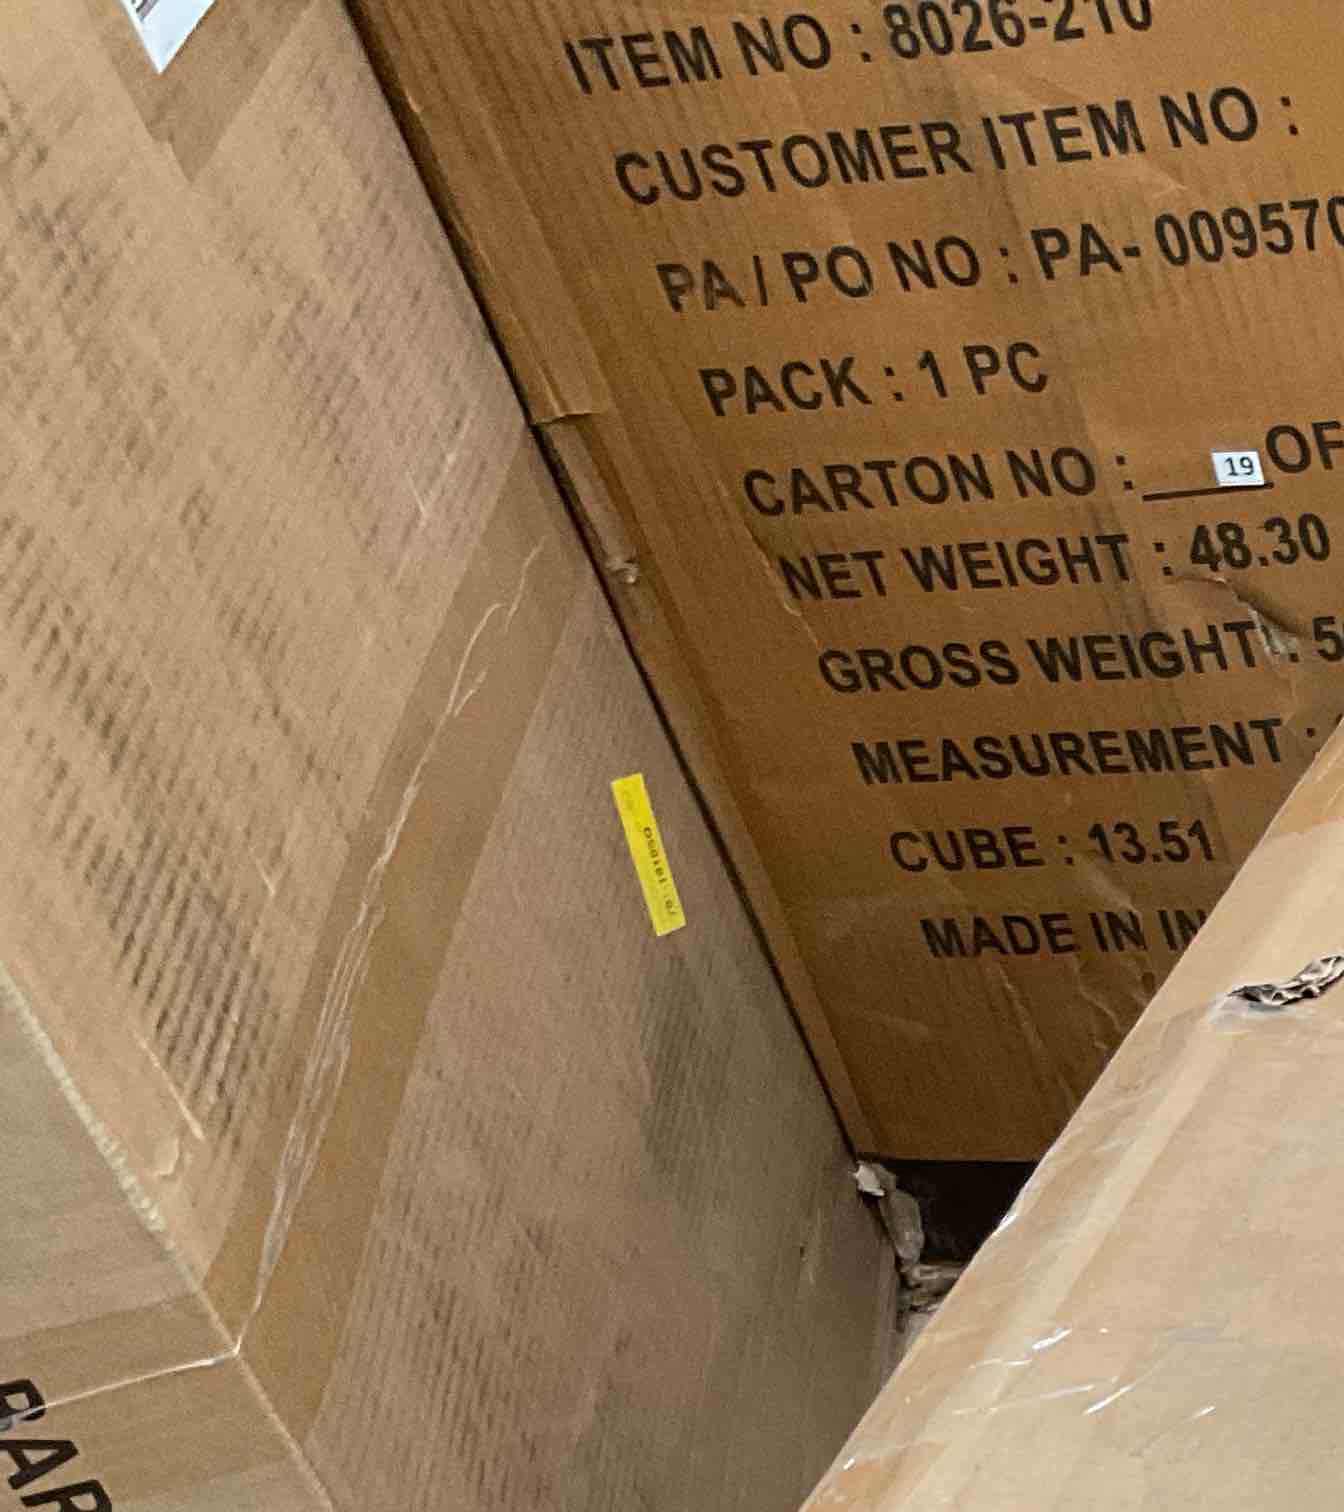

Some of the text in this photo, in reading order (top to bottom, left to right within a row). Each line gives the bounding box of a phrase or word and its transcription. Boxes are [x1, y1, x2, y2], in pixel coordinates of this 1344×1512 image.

[564, 27, 721, 95] ITEM
[740, 15, 832, 76] NO
[886, 0, 1152, 59] 8026-210
[615, 120, 974, 206] CUSTOMER
[983, 100, 1146, 171] ITEM
[1160, 86, 1258, 148] NO
[657, 259, 744, 314] PA
[784, 244, 872, 303] PO
[888, 235, 981, 292] NO
[699, 355, 875, 417] PACK
[918, 350, 948, 398] 1
[961, 341, 1049, 396] PC
[743, 453, 994, 517] CARTON
[1007, 447, 1096, 498] NO
[1223, 456, 1254, 477] 19
[778, 550, 884, 600] NET
[902, 534, 1129, 593] WEIGHT
[1189, 513, 1329, 572] 48.30
[818, 640, 1020, 695] GROSS
[1026, 621, 1257, 684] WEIGHT
[850, 717, 1283, 785] MEASUREMENT
[890, 826, 1045, 873] CUBE
[1087, 819, 1217, 866] 13.51
[920, 913, 1079, 960] MADE
[1092, 910, 1148, 953] IN
